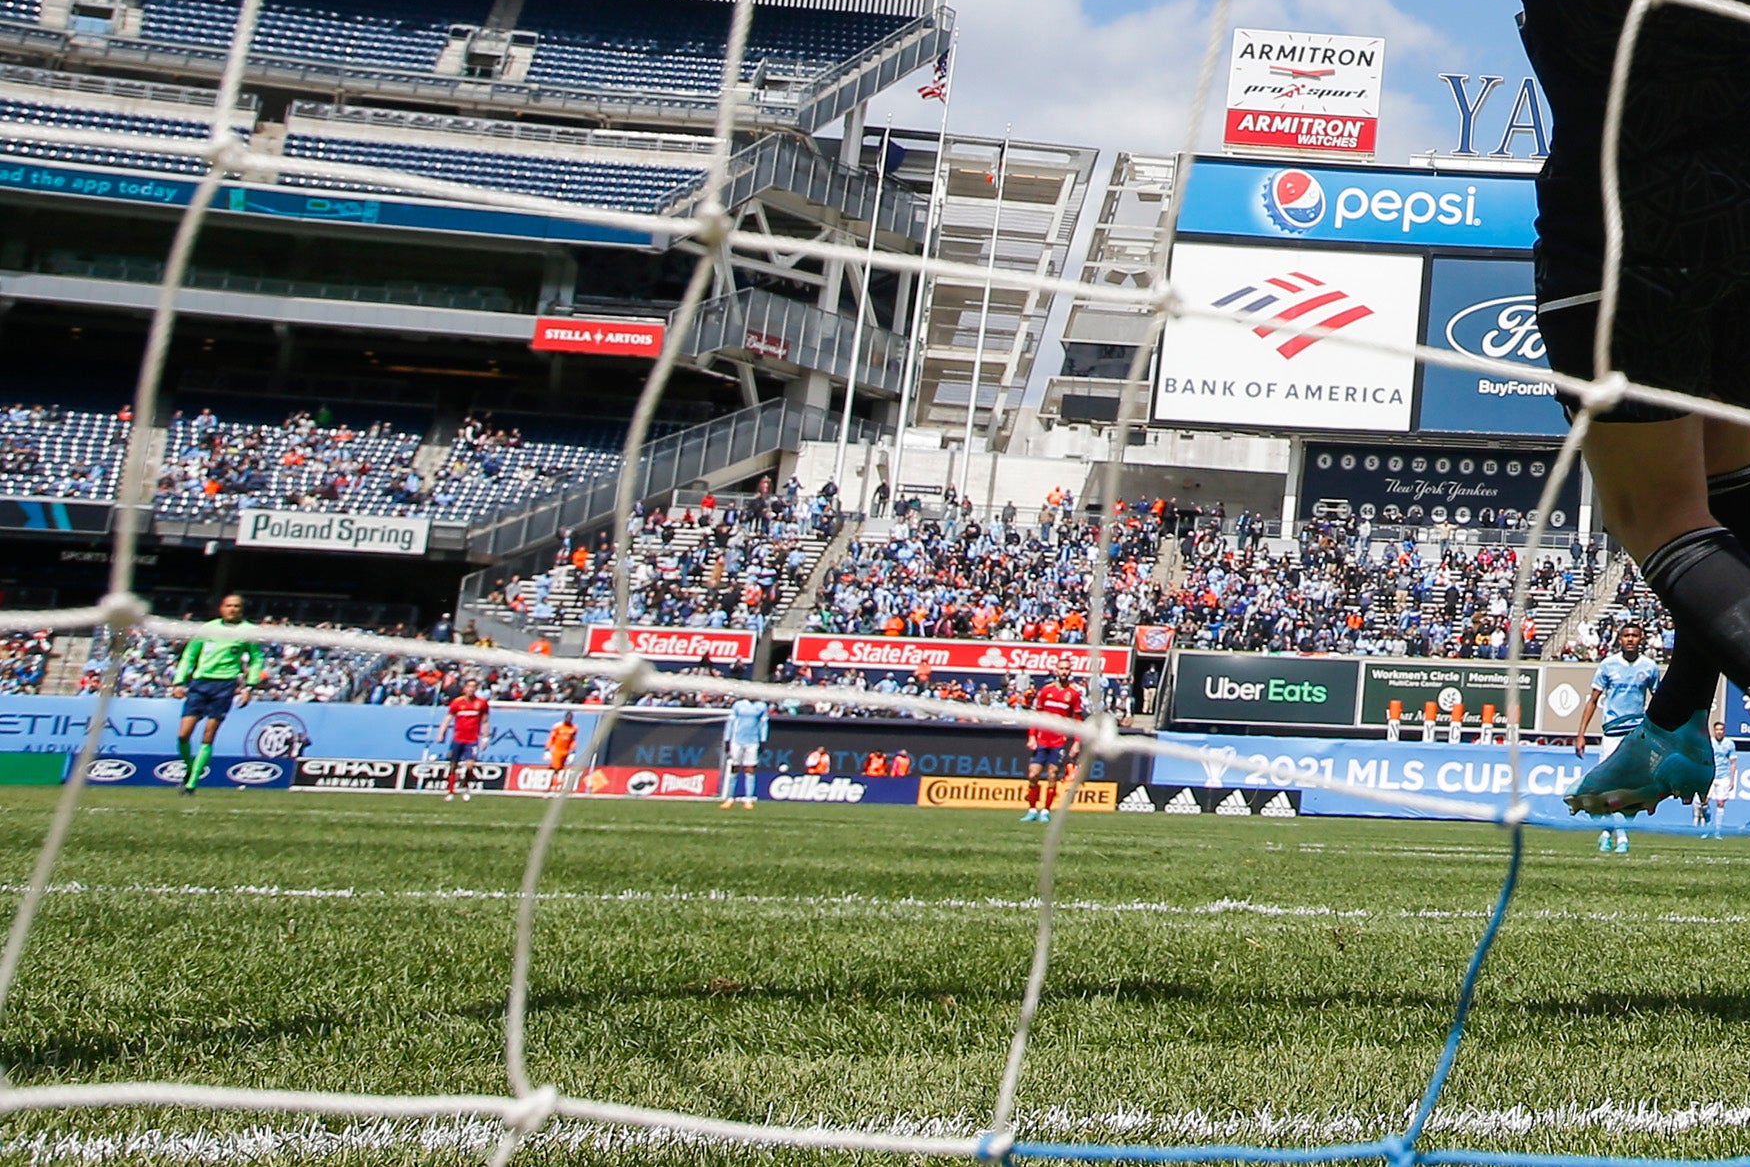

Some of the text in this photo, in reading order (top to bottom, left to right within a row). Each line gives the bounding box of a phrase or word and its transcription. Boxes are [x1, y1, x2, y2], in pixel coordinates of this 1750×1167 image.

[1238, 42, 1376, 67] ARMITRON
[1237, 113, 1362, 138] ARMITRON
[1437, 72, 1552, 160] YA
[1297, 133, 1359, 148] WATCHES
[31, 170, 66, 186] the
[71, 176, 112, 194] app
[118, 178, 178, 202] today
[1334, 185, 1477, 233] pepsi
[544, 328, 654, 345] STELLA ARTOIS
[1481, 304, 1547, 360] Fo
[1164, 376, 1405, 406] BANK OF AMERICA
[1385, 478, 1499, 502] New York Yankees
[251, 514, 414, 550] Poland Spring
[1372, 669, 1460, 682] Workmen's Circle
[1468, 672, 1531, 685] Morningide
[1205, 676, 1328, 703] Uber Eats
[0, 713, 159, 737] ETIHAD
[302, 761, 395, 777] ETIHAD
[1243, 754, 1334, 787] 2021
[1345, 760, 1425, 791] MLS
[1436, 762, 1514, 795] CUP
[768, 774, 867, 803] Gillette
[926, 779, 1040, 805] Continenta
